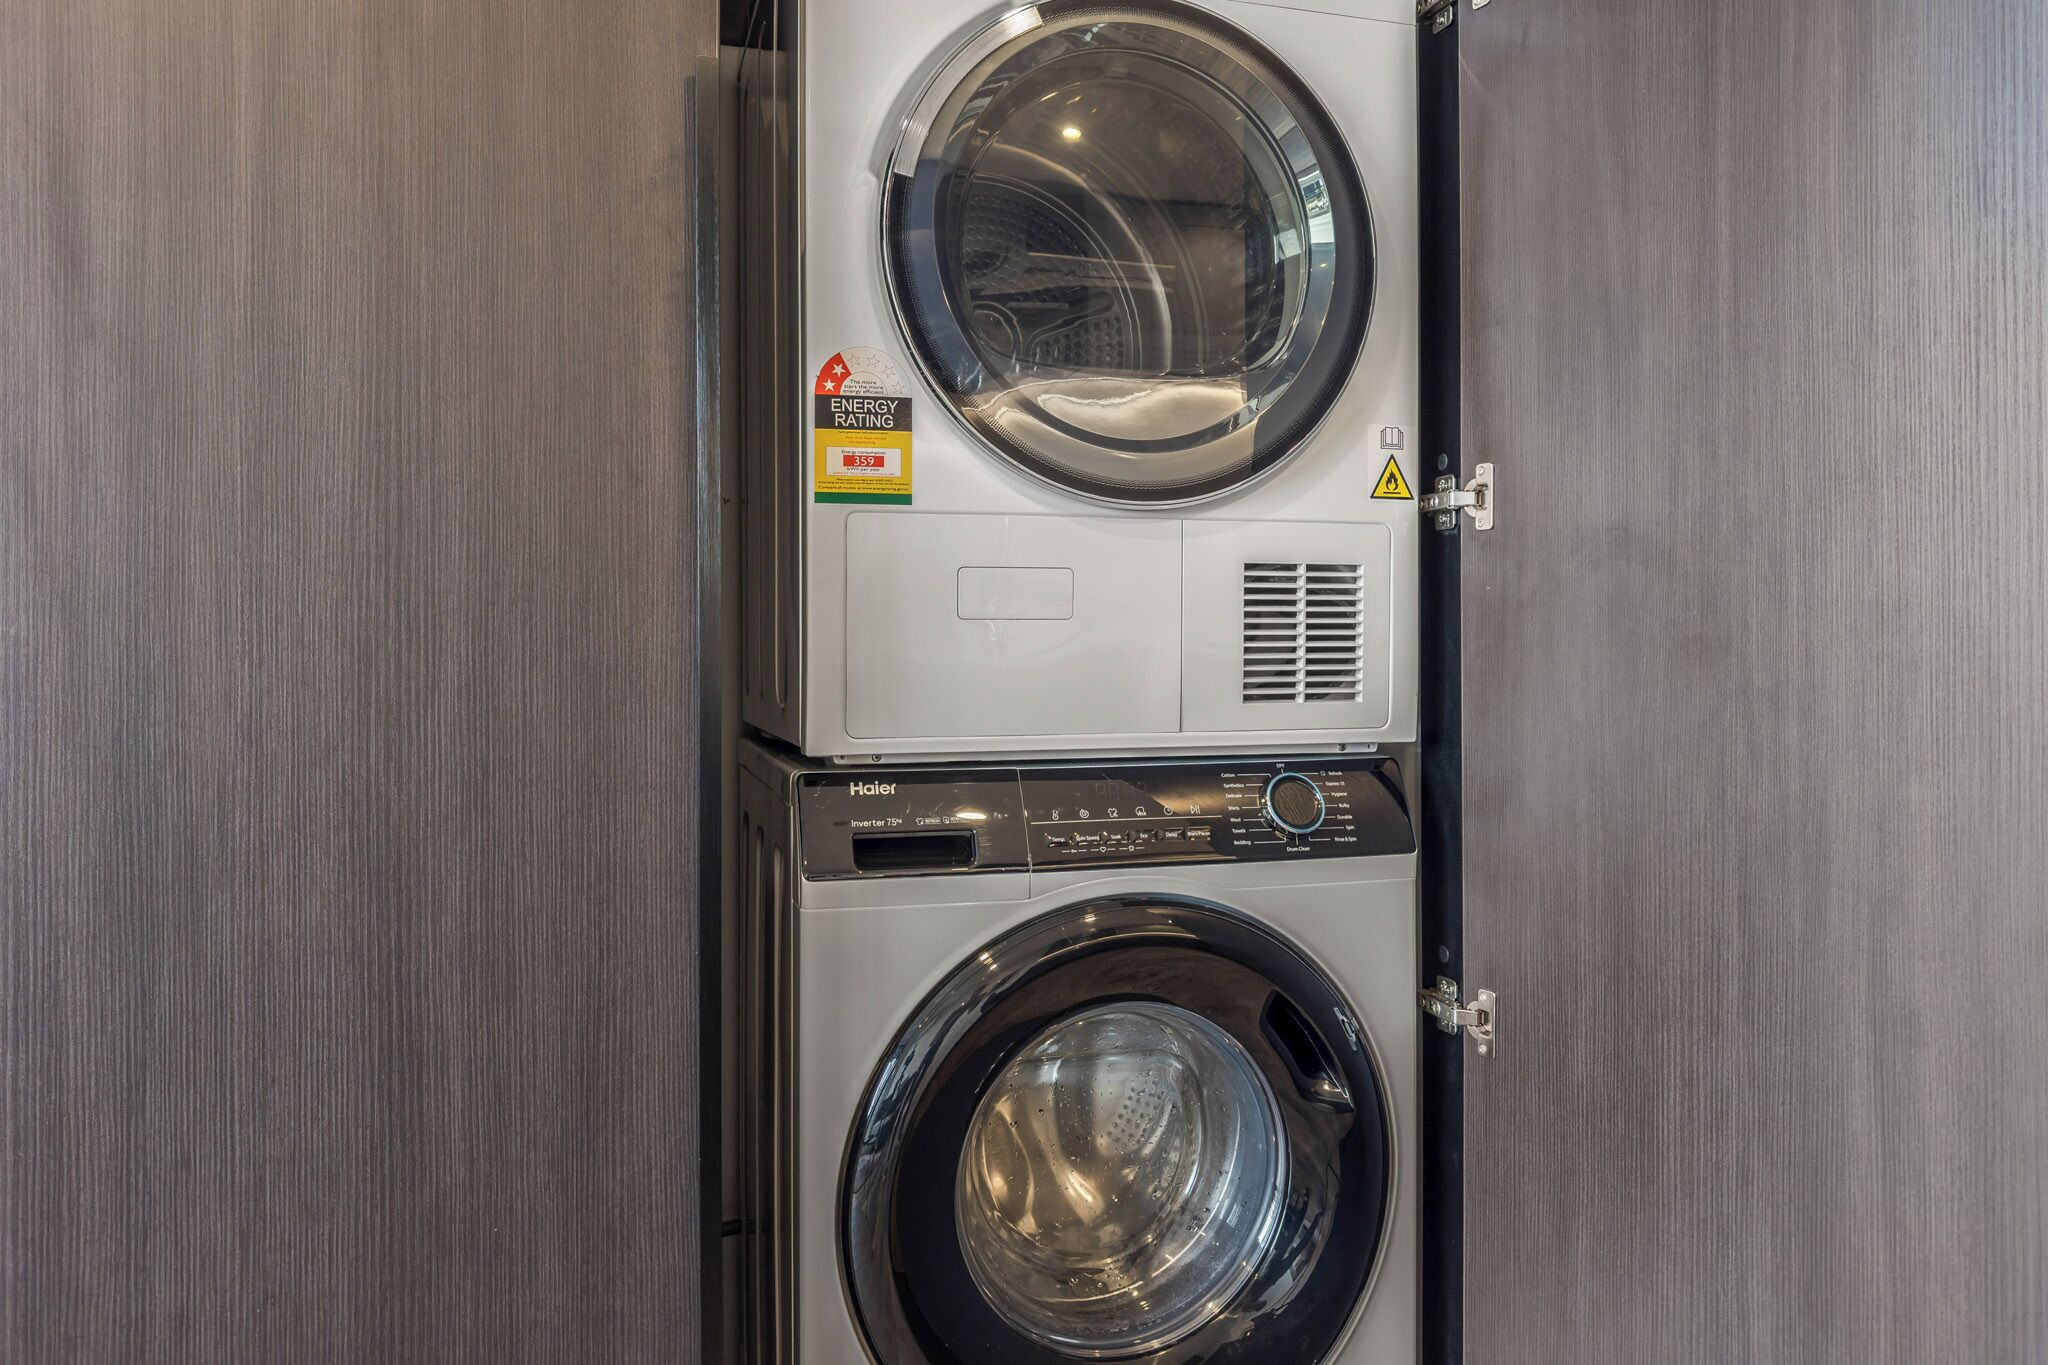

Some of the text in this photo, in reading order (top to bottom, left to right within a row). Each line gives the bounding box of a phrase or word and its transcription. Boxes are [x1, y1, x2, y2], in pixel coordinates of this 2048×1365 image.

[831, 398, 899, 414] ENERGY
[834, 413, 894, 428] RATING
[853, 456, 875, 466] 359
[849, 780, 897, 796] Haier
[851, 818, 885, 828] Inverter
